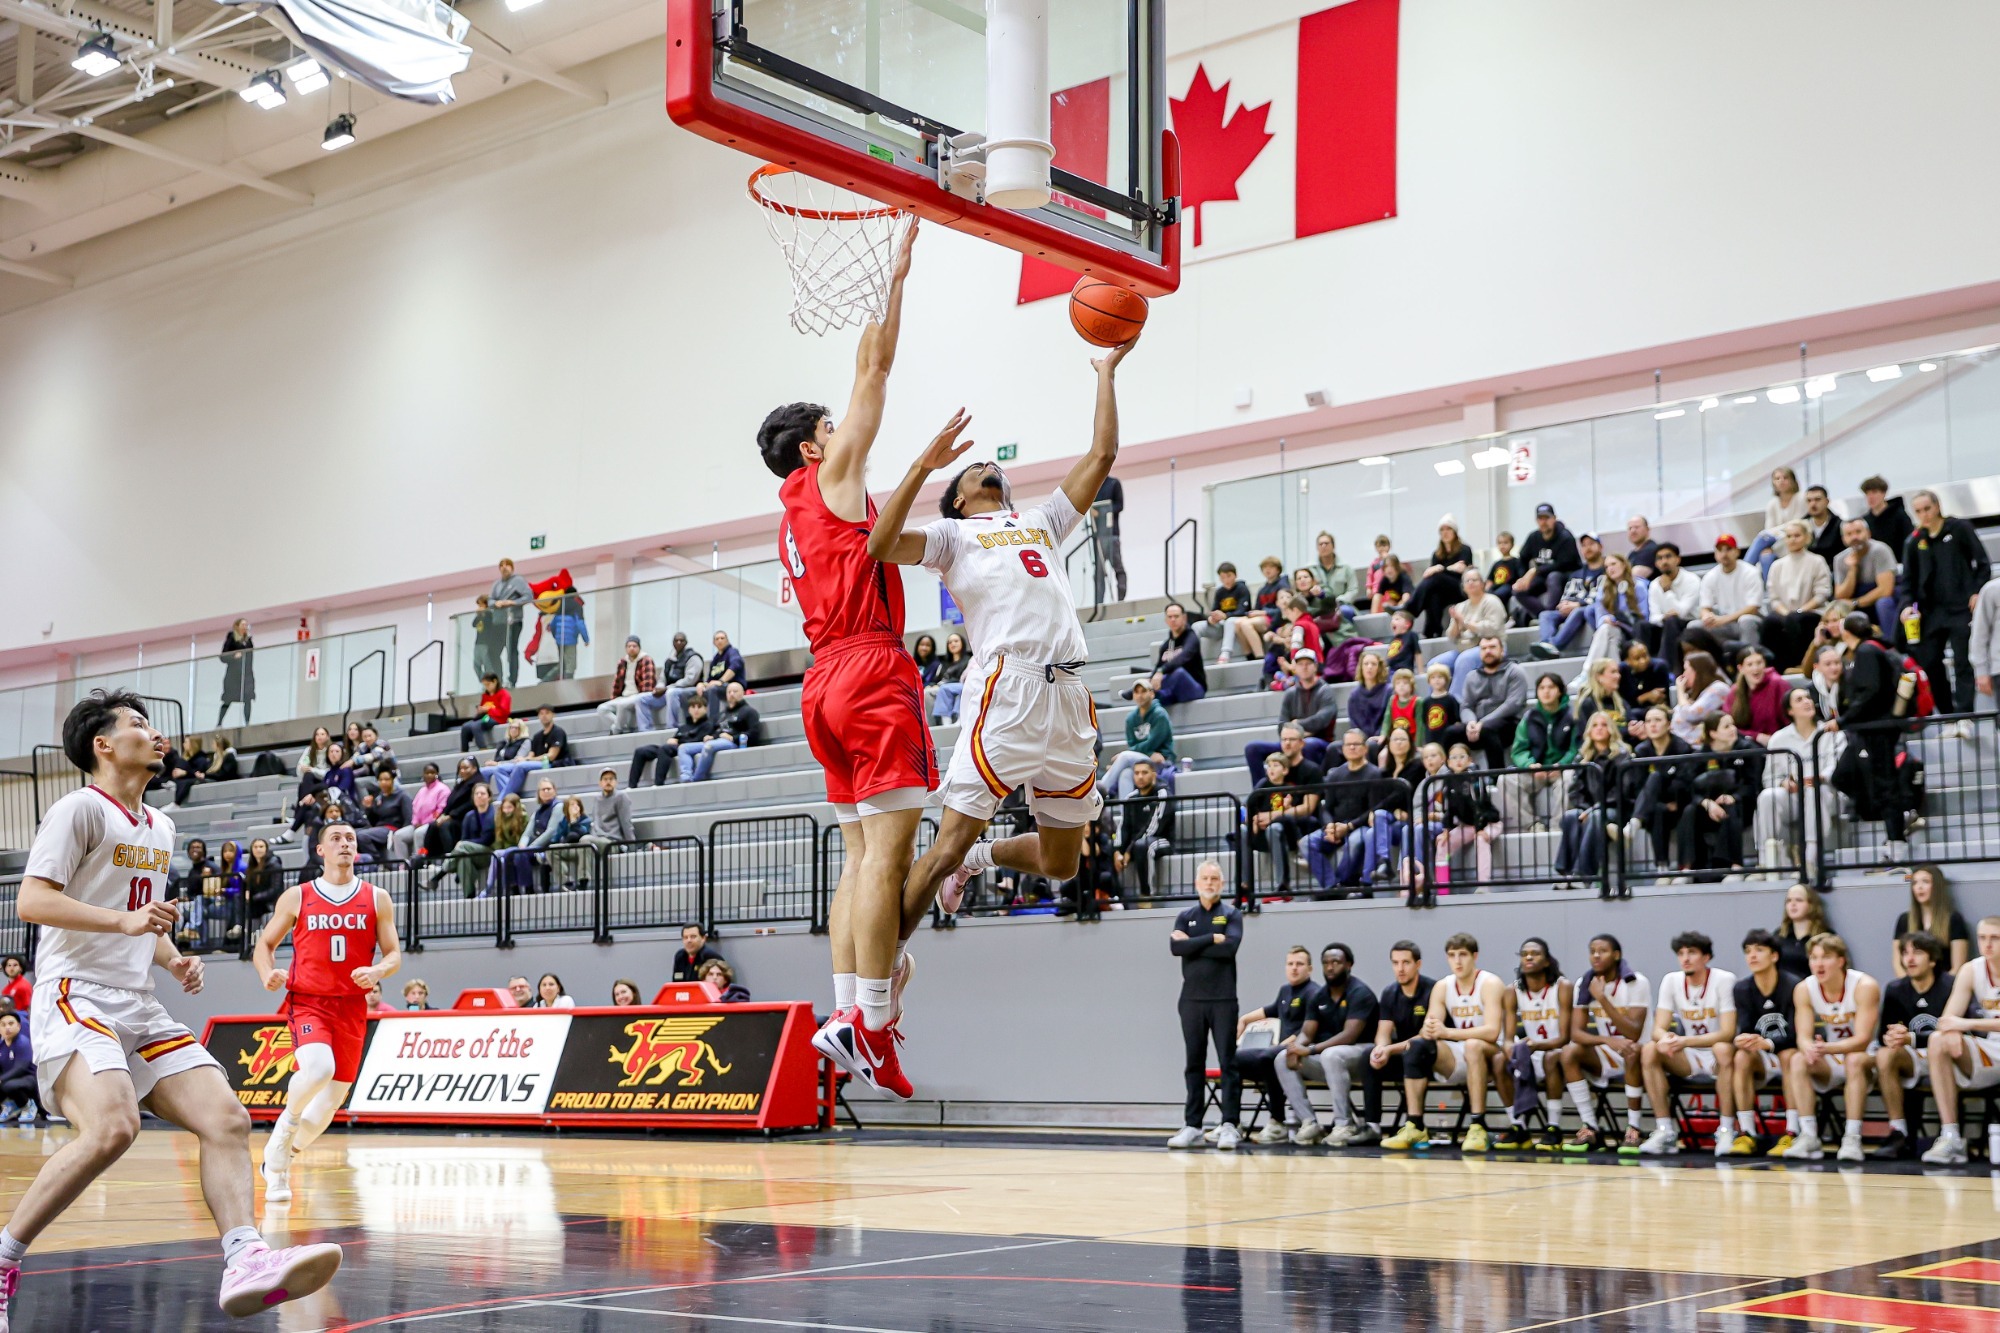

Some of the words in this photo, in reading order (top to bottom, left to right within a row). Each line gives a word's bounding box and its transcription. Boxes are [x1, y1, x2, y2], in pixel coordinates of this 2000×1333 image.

[1018, 549, 1049, 577] 6
[781, 577, 792, 603] B
[308, 655, 316, 678] A
[112, 843, 171, 874] GUELPH
[127, 876, 153, 911] 10
[307, 913, 367, 931] BROCK
[330, 934, 346, 962] 0
[301, 1024, 313, 1035] B
[1537, 1024, 1548, 1039] 4
[396, 1031, 465, 1058] Home
[469, 1028, 500, 1058] of
[497, 1028, 534, 1058] the
[250, 1090, 273, 1105] BE
[268, 1090, 283, 1105] A
[366, 1073, 541, 1102] GRYPHONS
[550, 1092, 613, 1109] PROUD
[609, 1092, 635, 1109] TO
[631, 1092, 659, 1109] BE
[654, 1092, 671, 1110] A
[671, 1093, 760, 1110] GRYPHON
